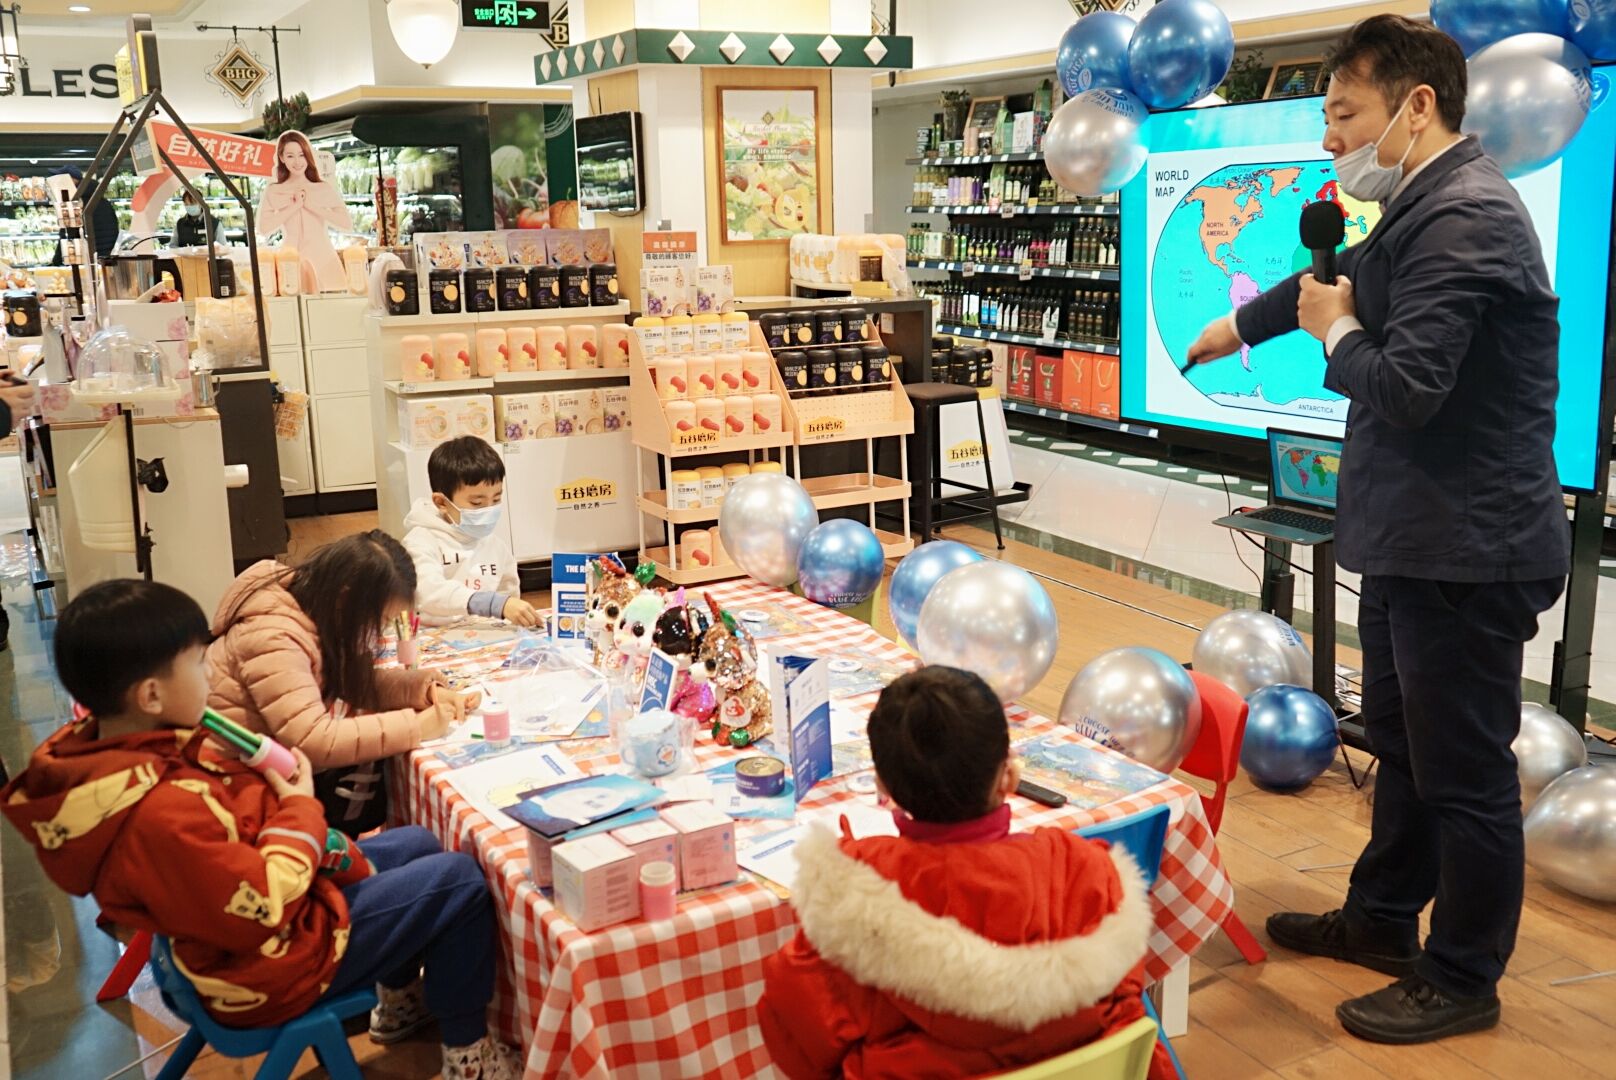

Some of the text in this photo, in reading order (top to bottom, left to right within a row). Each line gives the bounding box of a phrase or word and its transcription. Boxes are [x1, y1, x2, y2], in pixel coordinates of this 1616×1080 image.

[225, 68, 258, 80] BHG
[168, 133, 262, 166] 自然好礼
[1155, 170, 1189, 181] WORLD
[1155, 186, 1175, 197] MAP
[1298, 404, 1334, 414] ANTARCTICA
[808, 421, 843, 432] 五谷磨房
[680, 432, 716, 444] 五谷磨房
[560, 484, 612, 500] 五谷磨房
[565, 565, 578, 573] THE
